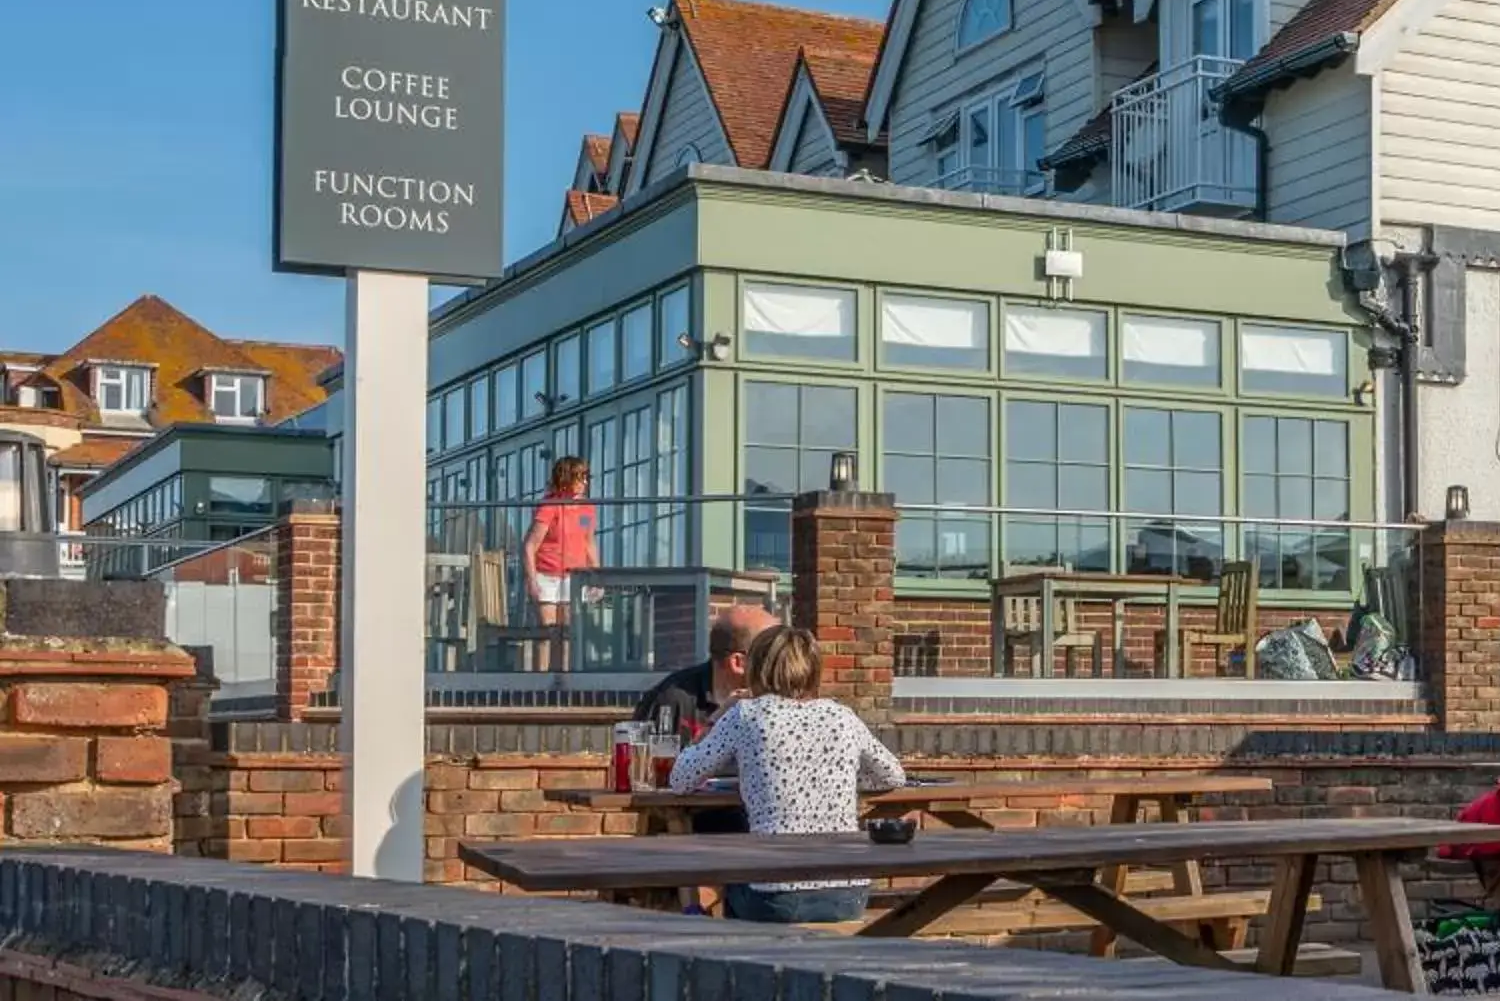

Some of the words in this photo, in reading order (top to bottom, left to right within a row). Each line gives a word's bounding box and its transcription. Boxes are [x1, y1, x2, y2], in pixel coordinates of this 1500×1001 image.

[341, 66, 450, 100] COFFEE
[335, 96, 458, 130] LOUNGE
[314, 170, 475, 206] FUNCTION
[341, 202, 449, 234] ROOMS
